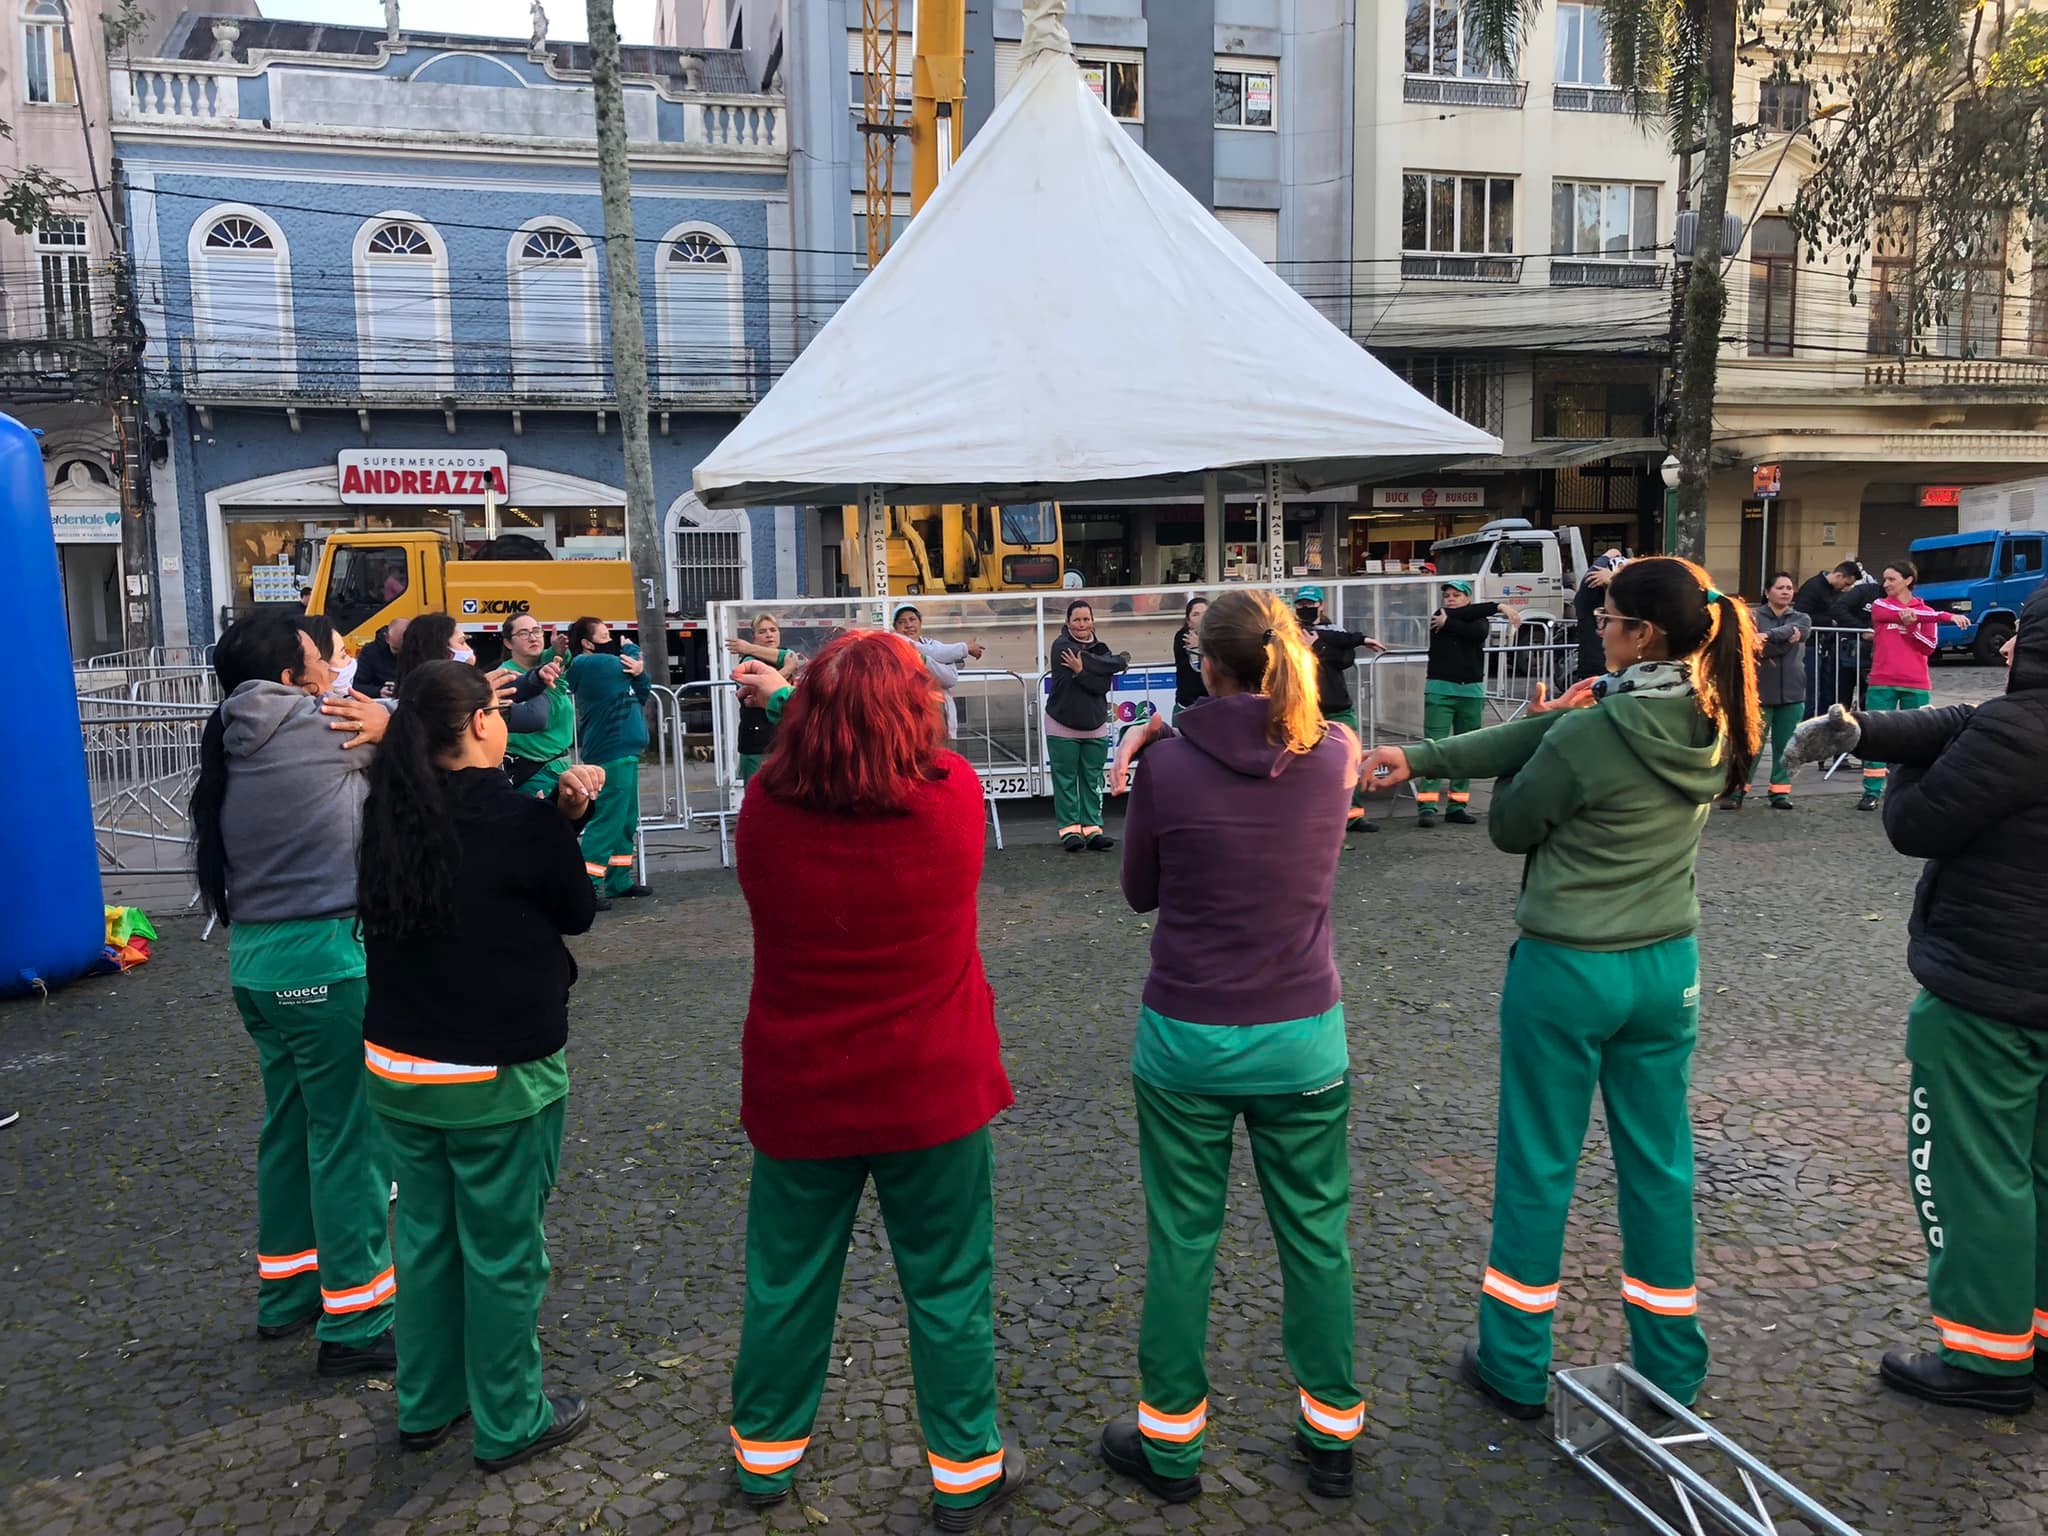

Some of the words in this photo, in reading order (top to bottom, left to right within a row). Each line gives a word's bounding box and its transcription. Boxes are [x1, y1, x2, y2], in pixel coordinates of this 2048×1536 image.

[364, 457, 485, 467] SUPERMERCADOS
[342, 465, 507, 495] ANDREAZZA
[872, 484, 884, 521] ELFIE
[1385, 492, 1409, 503] BUCK
[1445, 492, 1479, 503] BURGER
[1271, 515, 1282, 536] NAS
[874, 529, 884, 551] NAS
[1272, 544, 1283, 595] ALTURS
[480, 600, 530, 614] XCMG
[1911, 1086, 1944, 1249] codeca
